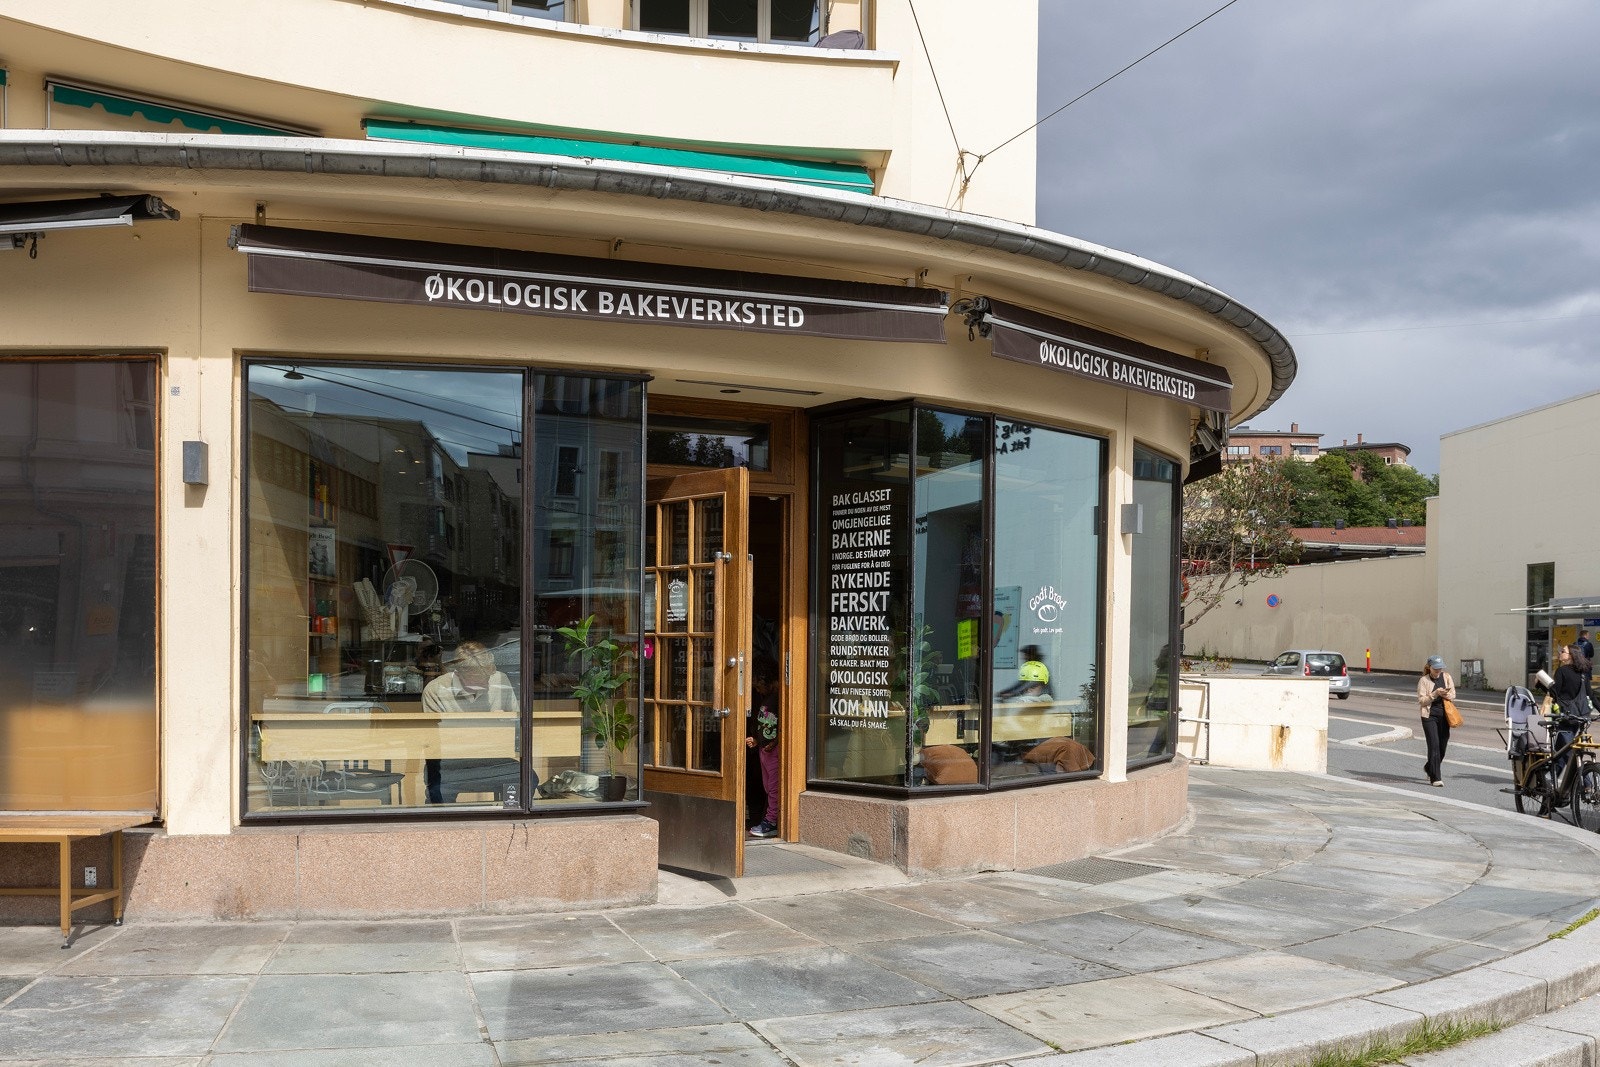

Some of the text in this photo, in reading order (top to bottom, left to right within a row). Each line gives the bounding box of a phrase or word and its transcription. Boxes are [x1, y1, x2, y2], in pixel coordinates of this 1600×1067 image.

[424, 273, 805, 328] ØKOLOGISK BAKEVERKSTED
[1039, 340, 1196, 400] ØKOLOGISK BAKEVERKSTED
[832, 488, 892, 506] BAK GLASSET
[879, 504, 892, 512] MEST
[832, 514, 891, 531] OMGJENGELIGE
[831, 529, 891, 550] BAKERNE
[834, 551, 855, 561] NORGE.
[855, 551, 863, 559] DE
[863, 547, 879, 559] STÅR
[878, 549, 891, 558] OPP
[860, 561, 871, 569] FOR
[870, 559, 875, 569] Å
[880, 560, 891, 568] DEG
[831, 571, 891, 590] RYKENDE
[831, 590, 890, 613] FERSKT
[1029, 585, 1067, 611] Godt Brød
[830, 615, 890, 631] BAKVERK.
[830, 633, 890, 642] GODE BRØD OG BOLLER.
[830, 645, 890, 656] RUNDSTYKKER
[830, 659, 890, 669] OG KAKER. BAKT MED
[830, 669, 889, 685] ØKOLOGISK
[830, 687, 841, 695] MEL
[841, 687, 850, 695] AV
[850, 688, 872, 696] FINESTE
[829, 698, 889, 719] KOM INN
[829, 717, 838, 727] SÅ
[837, 719, 851, 727] SKAL
[851, 720, 860, 728] DU
[859, 718, 867, 728] FÅ
